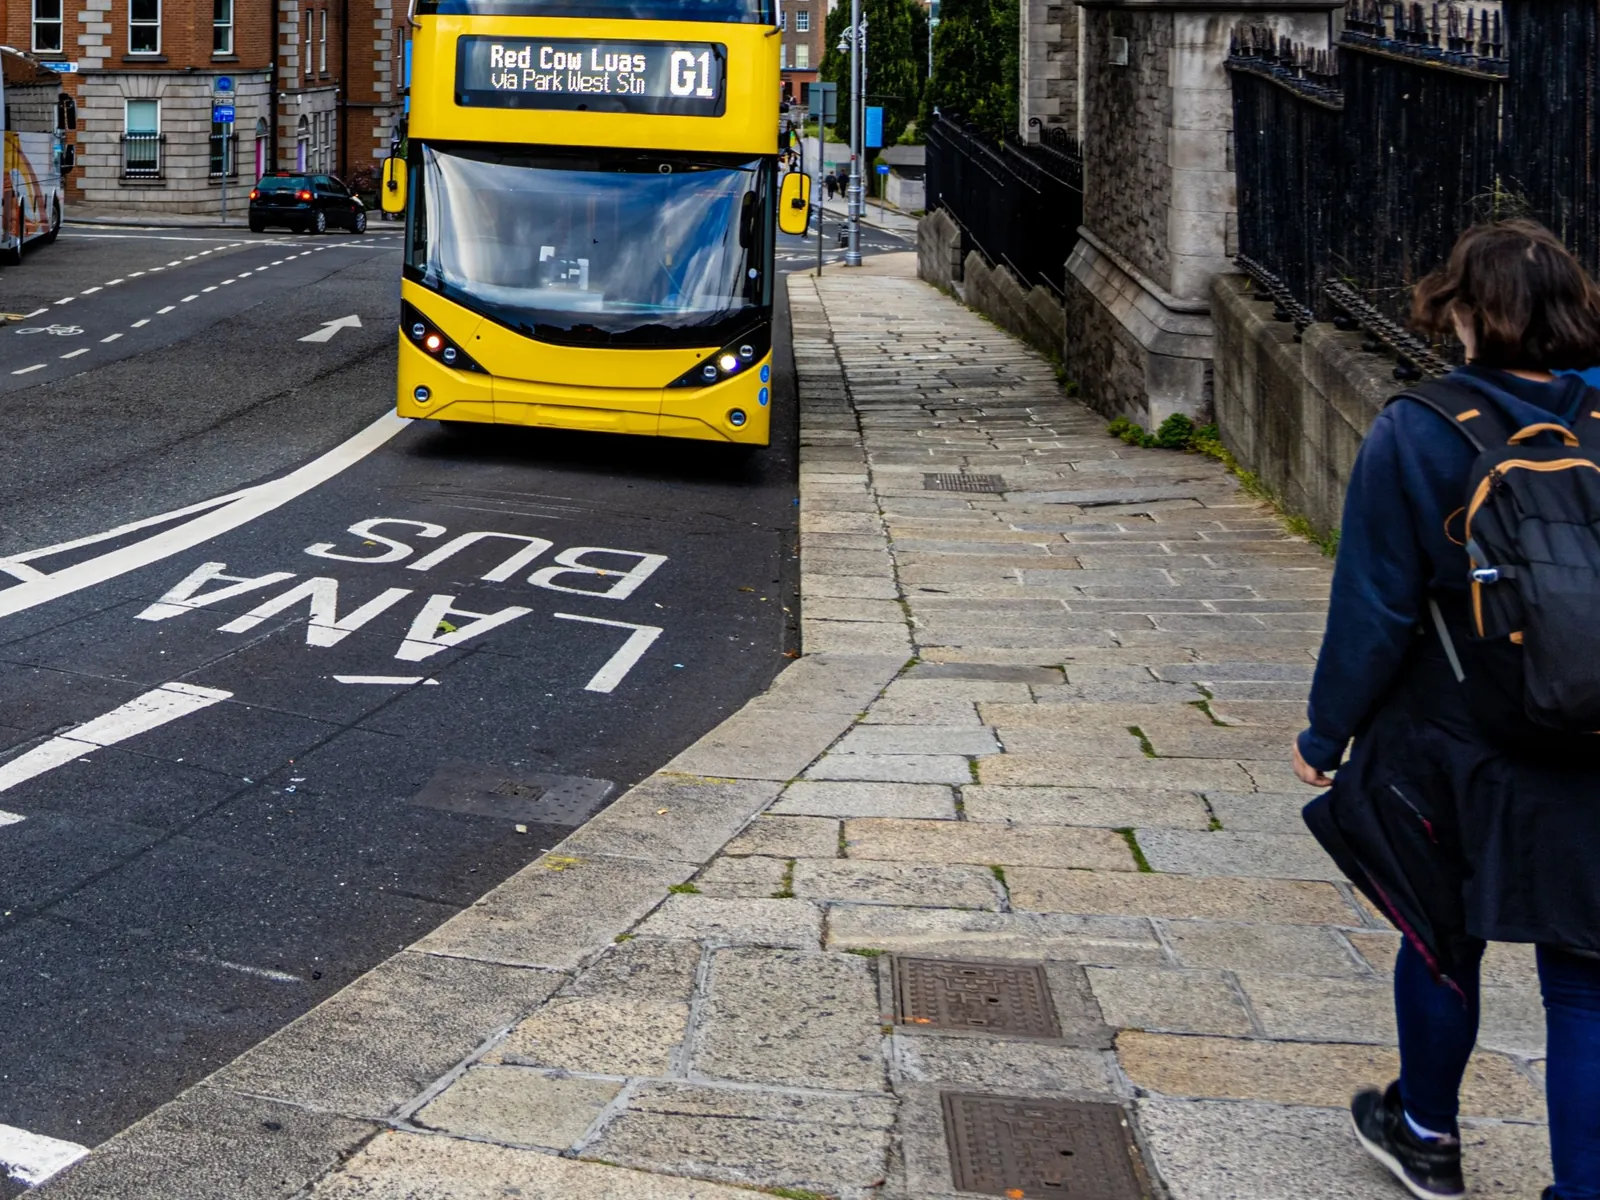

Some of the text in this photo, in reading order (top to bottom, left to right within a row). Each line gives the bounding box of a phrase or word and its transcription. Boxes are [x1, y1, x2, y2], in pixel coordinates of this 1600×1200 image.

[490, 44, 646, 73] Red Cow Luas
[491, 68, 646, 94] via Park West Stn
[669, 50, 714, 97] G1
[303, 516, 668, 600] BUS
[134, 562, 664, 693] LÁNA
